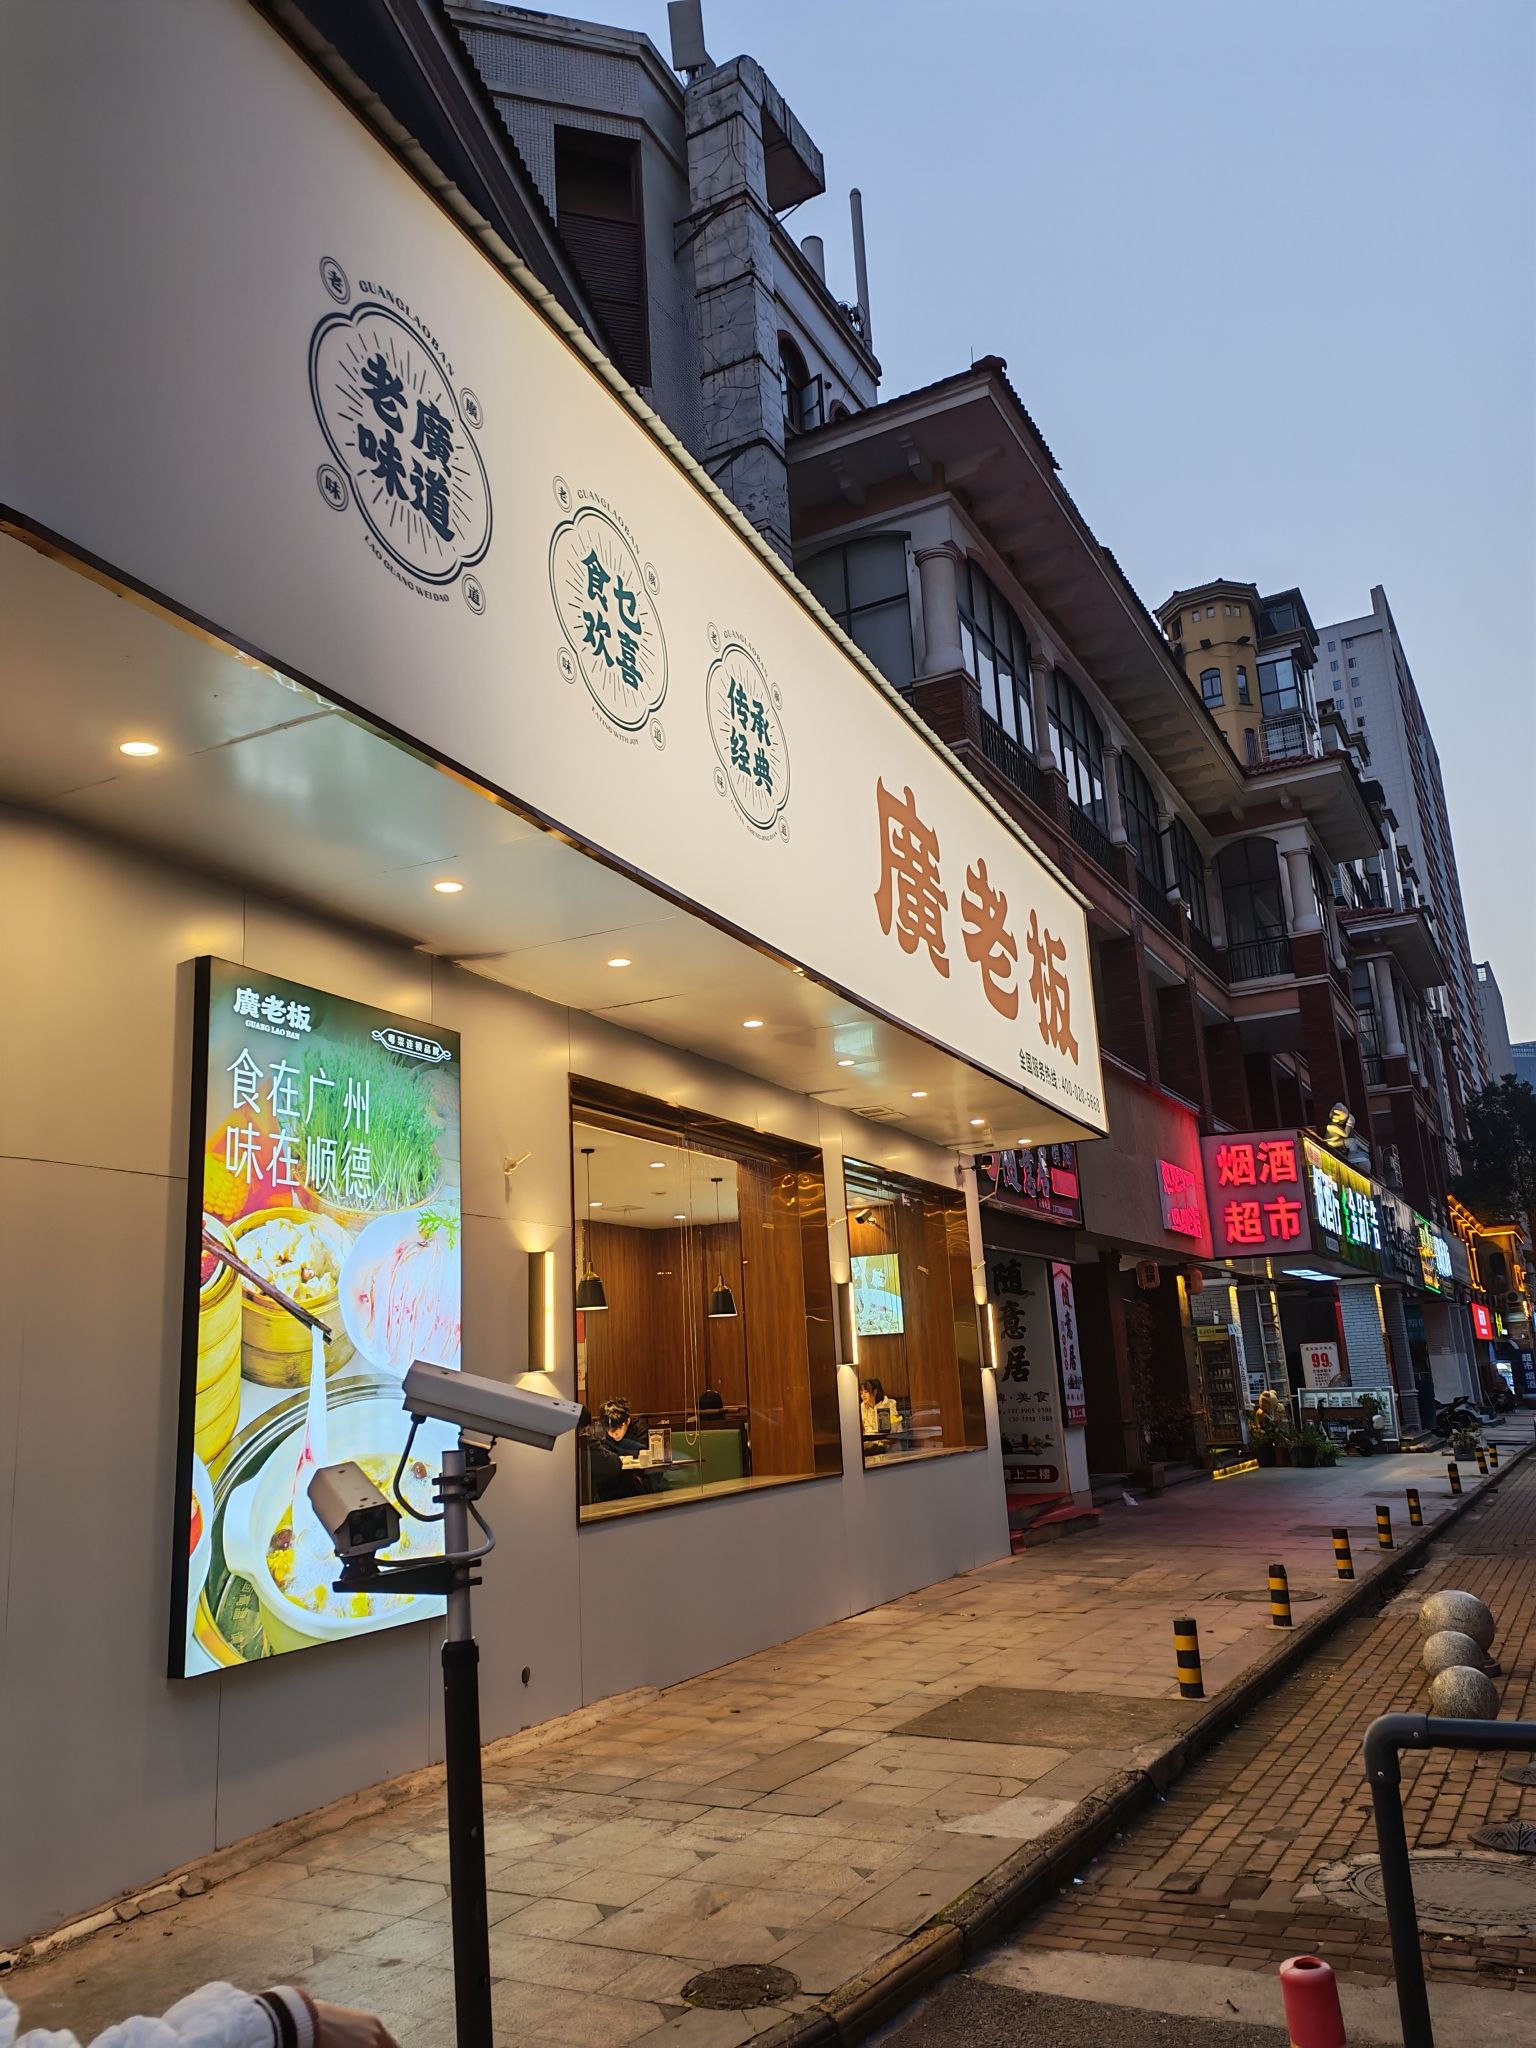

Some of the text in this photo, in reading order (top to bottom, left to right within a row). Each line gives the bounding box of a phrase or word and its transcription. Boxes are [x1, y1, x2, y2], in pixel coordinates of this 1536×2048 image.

[328, 268, 342, 293] 老
[325, 474, 341, 502] 味
[557, 486, 568, 504] 老
[364, 535, 383, 560] LAO
[467, 585, 482, 607] 道
[233, 987, 312, 1033] 廣老板
[245, 1019, 300, 1041] GUANG LAO BAN
[226, 1047, 371, 1135] 食在广州
[225, 1123, 372, 1199] 味在顺德
[1217, 1139, 1299, 1188] 烟酒
[1223, 1195, 1303, 1245] 超市
